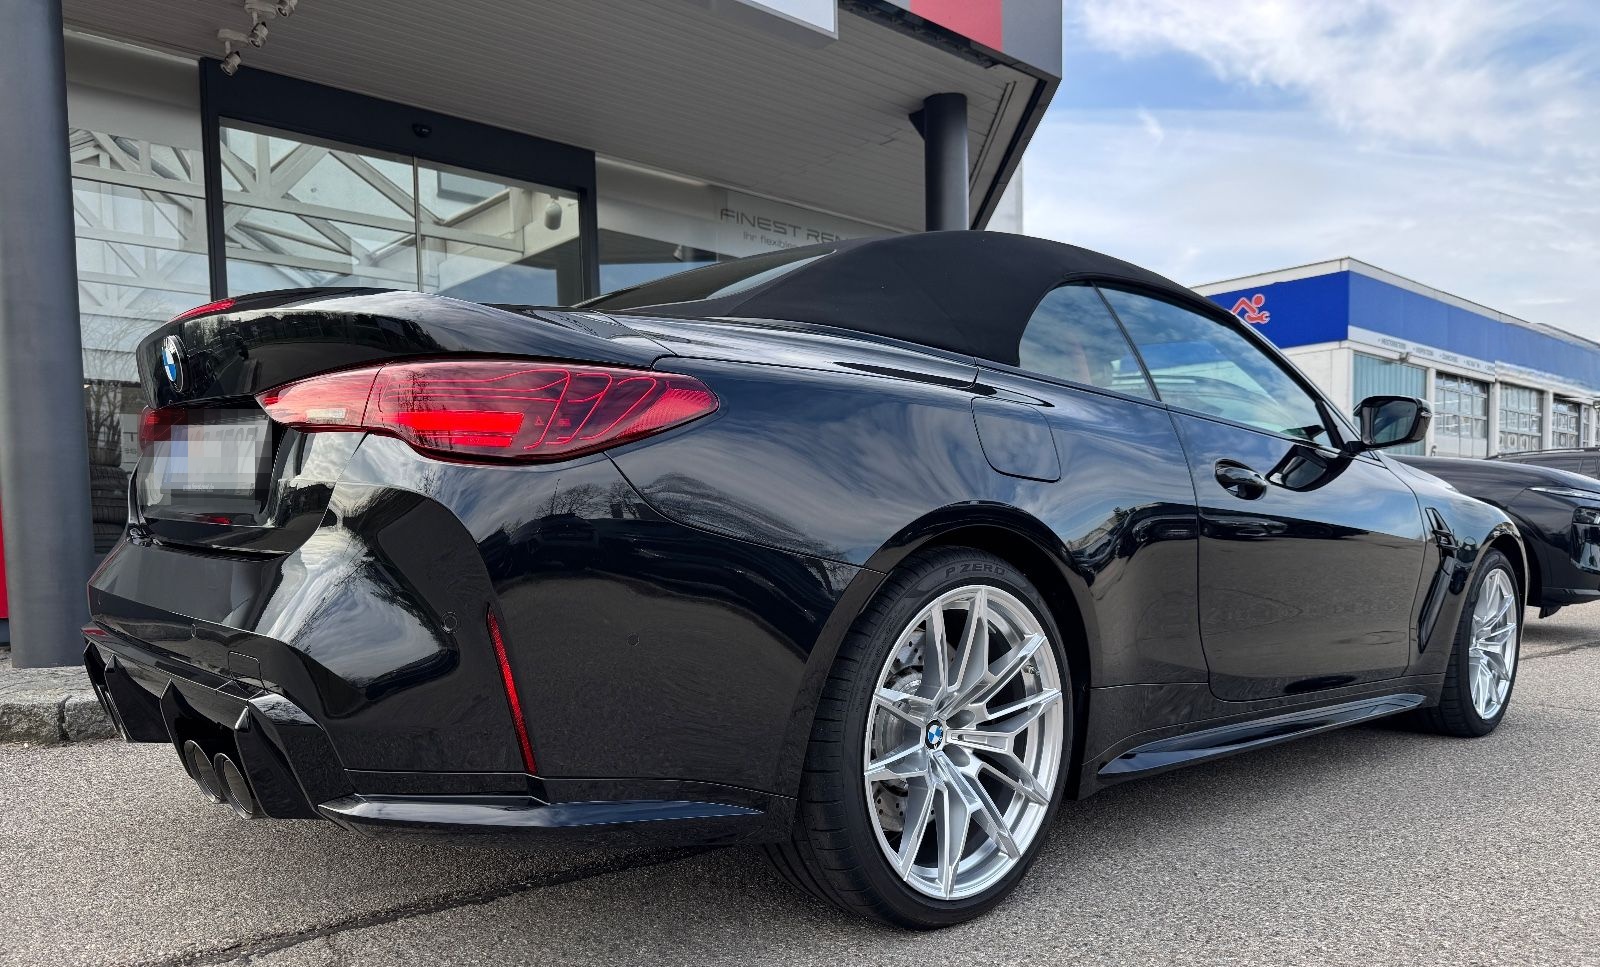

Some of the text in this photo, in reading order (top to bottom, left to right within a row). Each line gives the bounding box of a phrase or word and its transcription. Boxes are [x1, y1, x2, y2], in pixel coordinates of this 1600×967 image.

[721, 209, 801, 237] FINEST
[945, 563, 1006, 578] P ZERO
